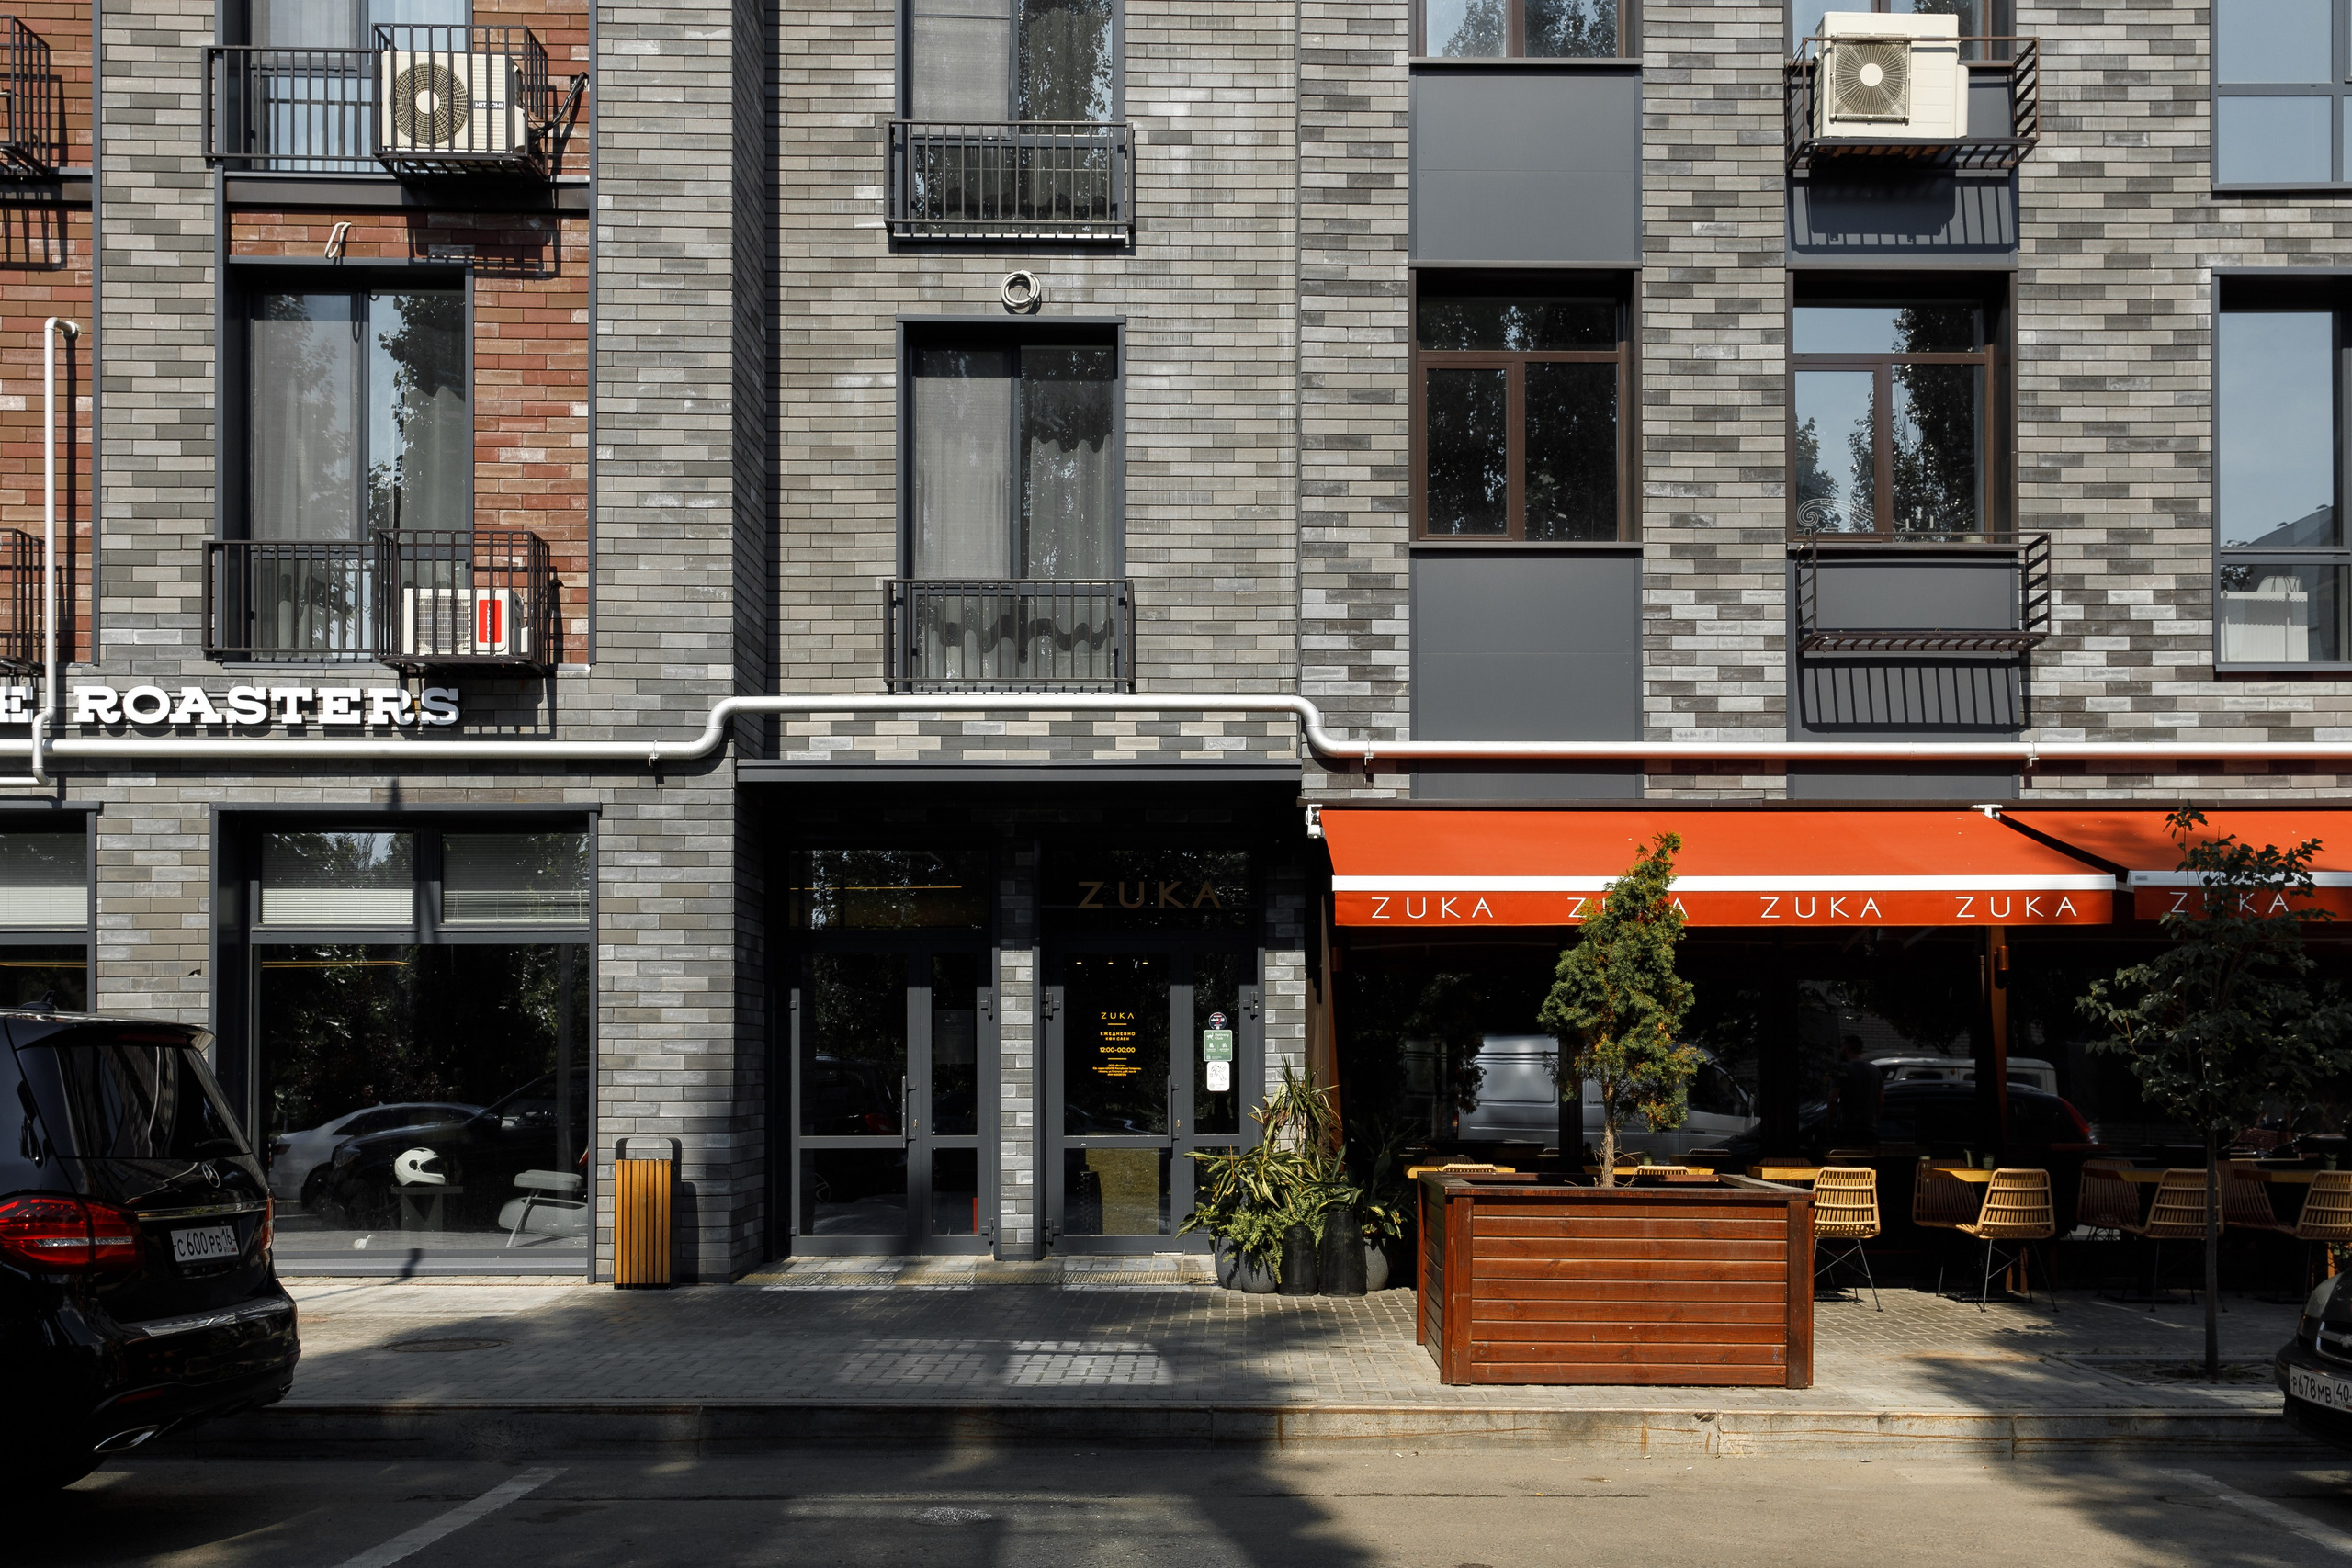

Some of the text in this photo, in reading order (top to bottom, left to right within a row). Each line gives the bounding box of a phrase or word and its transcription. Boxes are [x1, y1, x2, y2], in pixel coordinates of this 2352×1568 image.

[74, 686, 459, 725] ROASTERS
[1078, 881, 1222, 908] ZUKA
[1371, 897, 1494, 919] ZUKA
[1567, 897, 1689, 919] ZA
[1760, 897, 1882, 919] ZUKA
[1955, 896, 2077, 918] ZUKA
[1101, 1011, 1135, 1020] ZUKA
